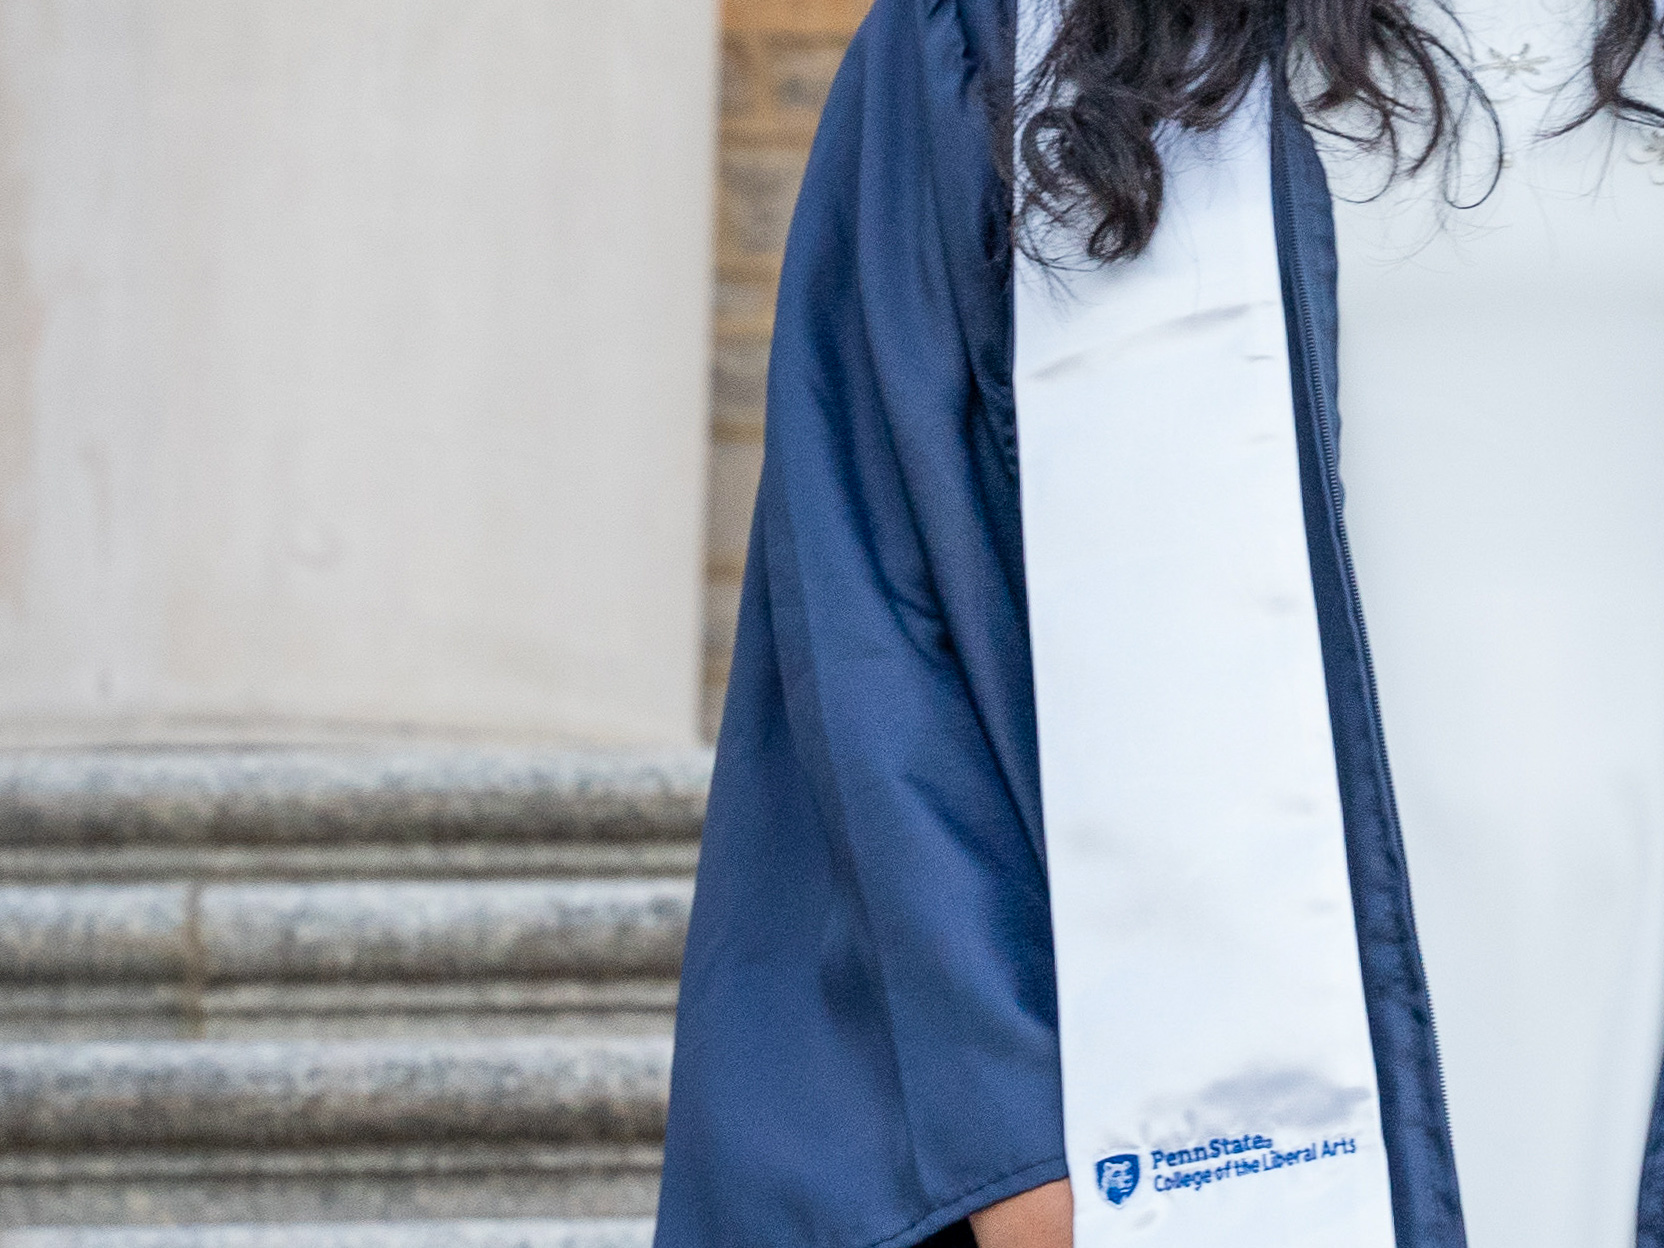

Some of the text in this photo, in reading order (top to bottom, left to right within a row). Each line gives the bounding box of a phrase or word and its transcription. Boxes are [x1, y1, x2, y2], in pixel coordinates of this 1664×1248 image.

[1154, 1137, 1356, 1191] College of the Liberal Arts
